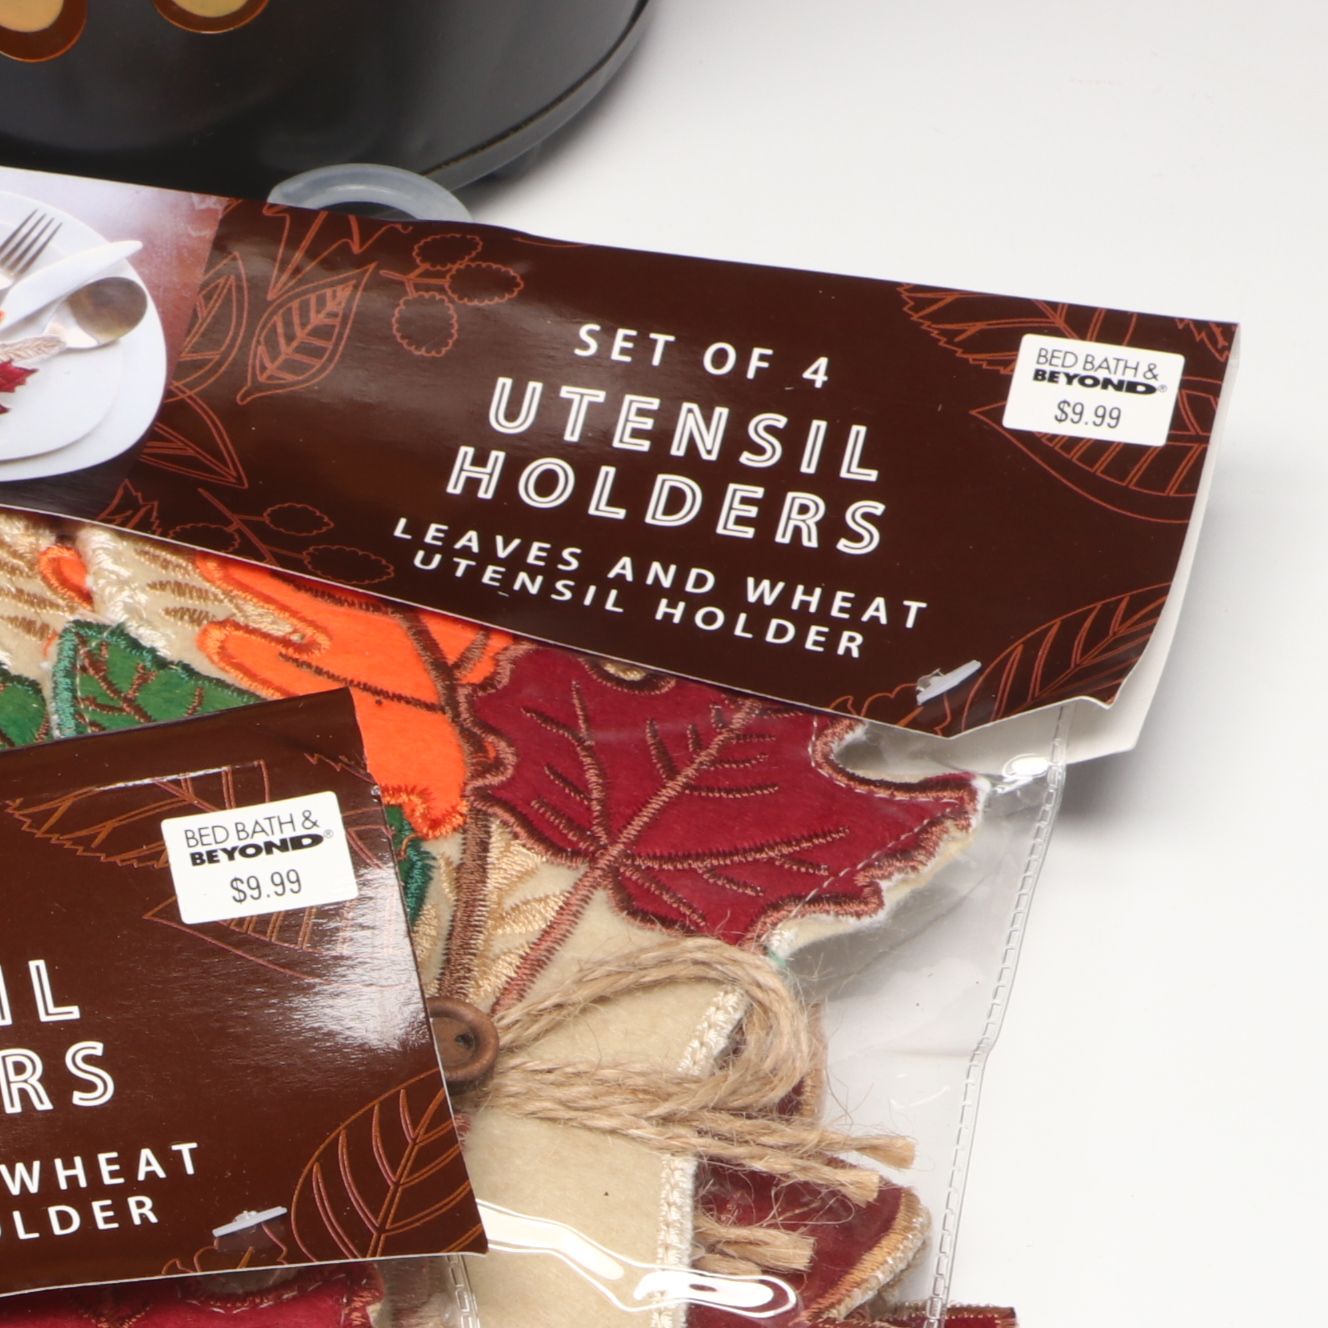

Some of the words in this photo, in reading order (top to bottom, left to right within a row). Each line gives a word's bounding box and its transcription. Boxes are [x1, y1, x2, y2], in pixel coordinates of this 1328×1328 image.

[573, 323, 675, 367] SET
[703, 342, 773, 380] OF
[802, 356, 831, 388] 4
[1035, 347, 1078, 369] BED
[1082, 353, 1140, 378] BATH
[1142, 362, 1160, 381] &
[488, 376, 879, 482] UTENSIL
[1054, 399, 1122, 430] $9.99
[445, 444, 886, 556] HOLDERS
[392, 516, 582, 572] LEAVES
[607, 556, 716, 594] AND
[746, 576, 929, 629] WHEAT
[413, 550, 625, 614] UTENSIL
[655, 598, 864, 658] HOLDER
[184, 825, 230, 849] BED
[234, 813, 297, 842] BATH
[301, 809, 321, 830] &
[230, 868, 303, 905] $9.99
